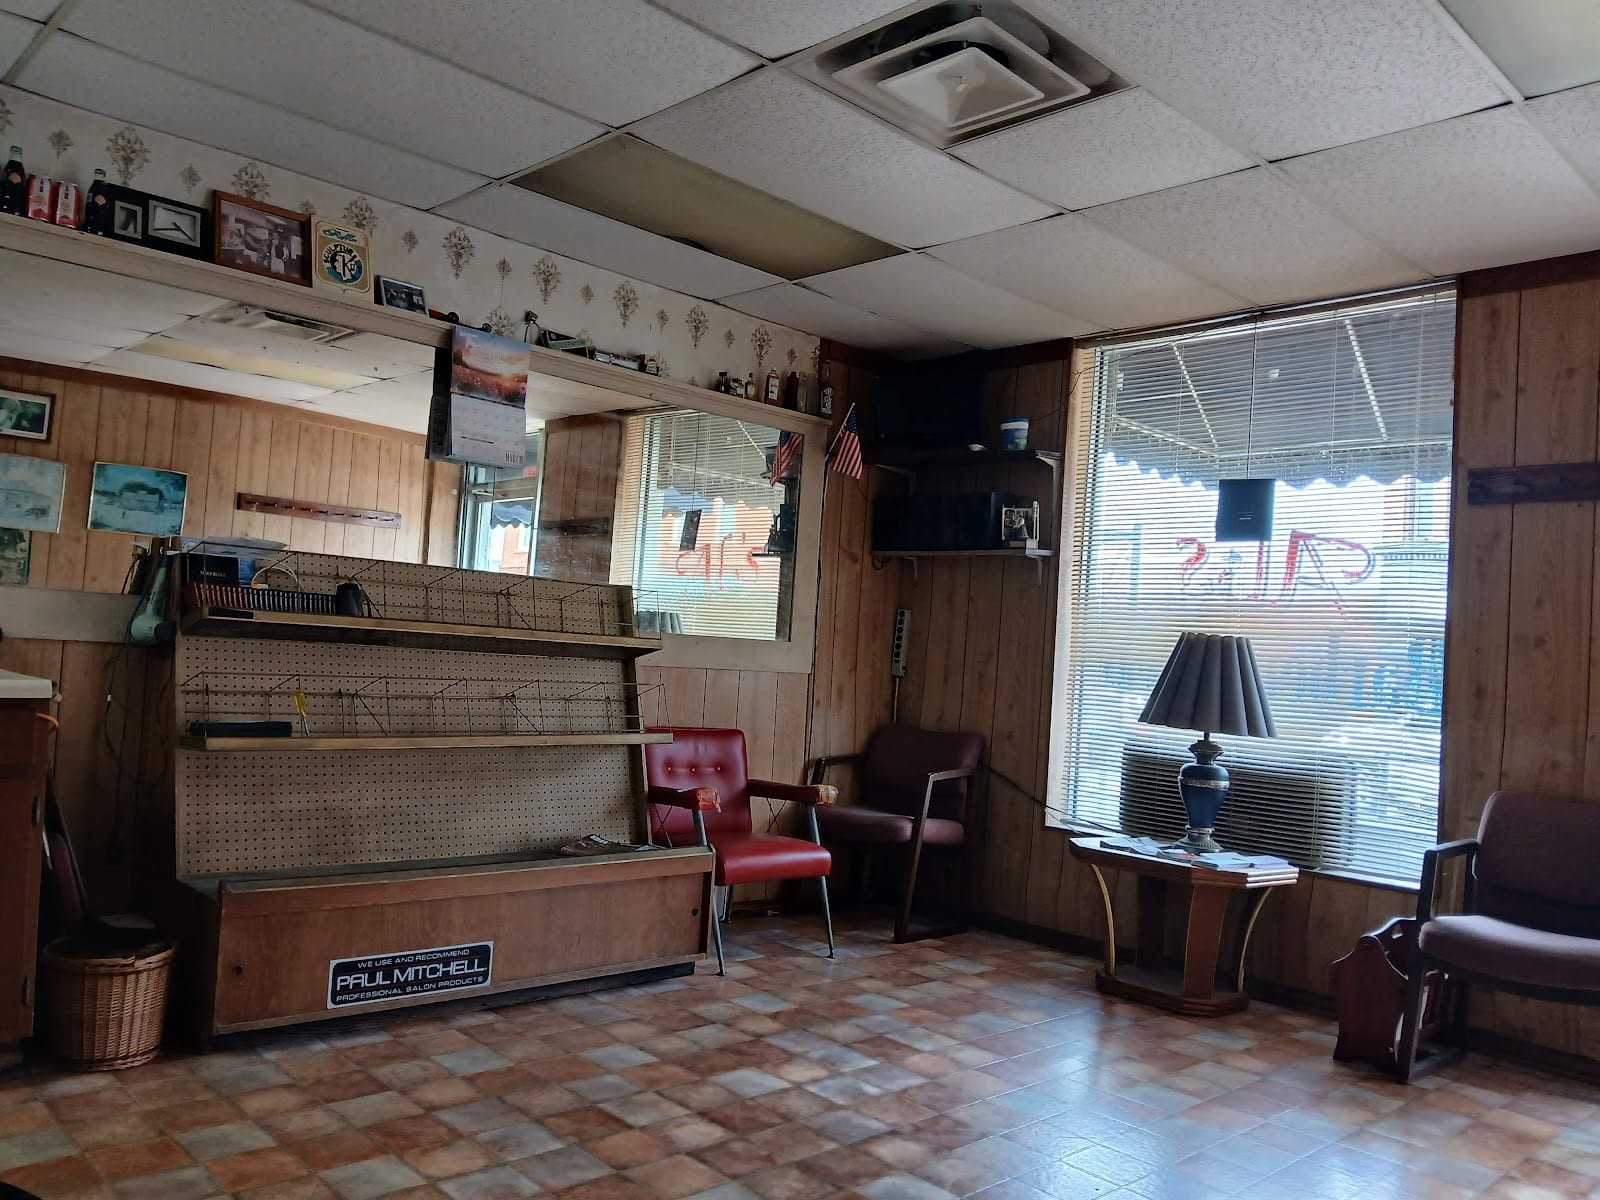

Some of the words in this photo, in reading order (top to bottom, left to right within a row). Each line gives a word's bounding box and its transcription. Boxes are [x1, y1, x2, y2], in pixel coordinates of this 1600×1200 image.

[357, 961, 373, 969] WE
[375, 958, 392, 967] USE
[395, 955, 414, 964] AND
[415, 949, 469, 961] RECOMMEND
[336, 974, 390, 991] PAUL
[336, 988, 403, 1002] PROFESSIONAL
[406, 983, 436, 993] SALON
[438, 976, 483, 988] PRODUCTS
